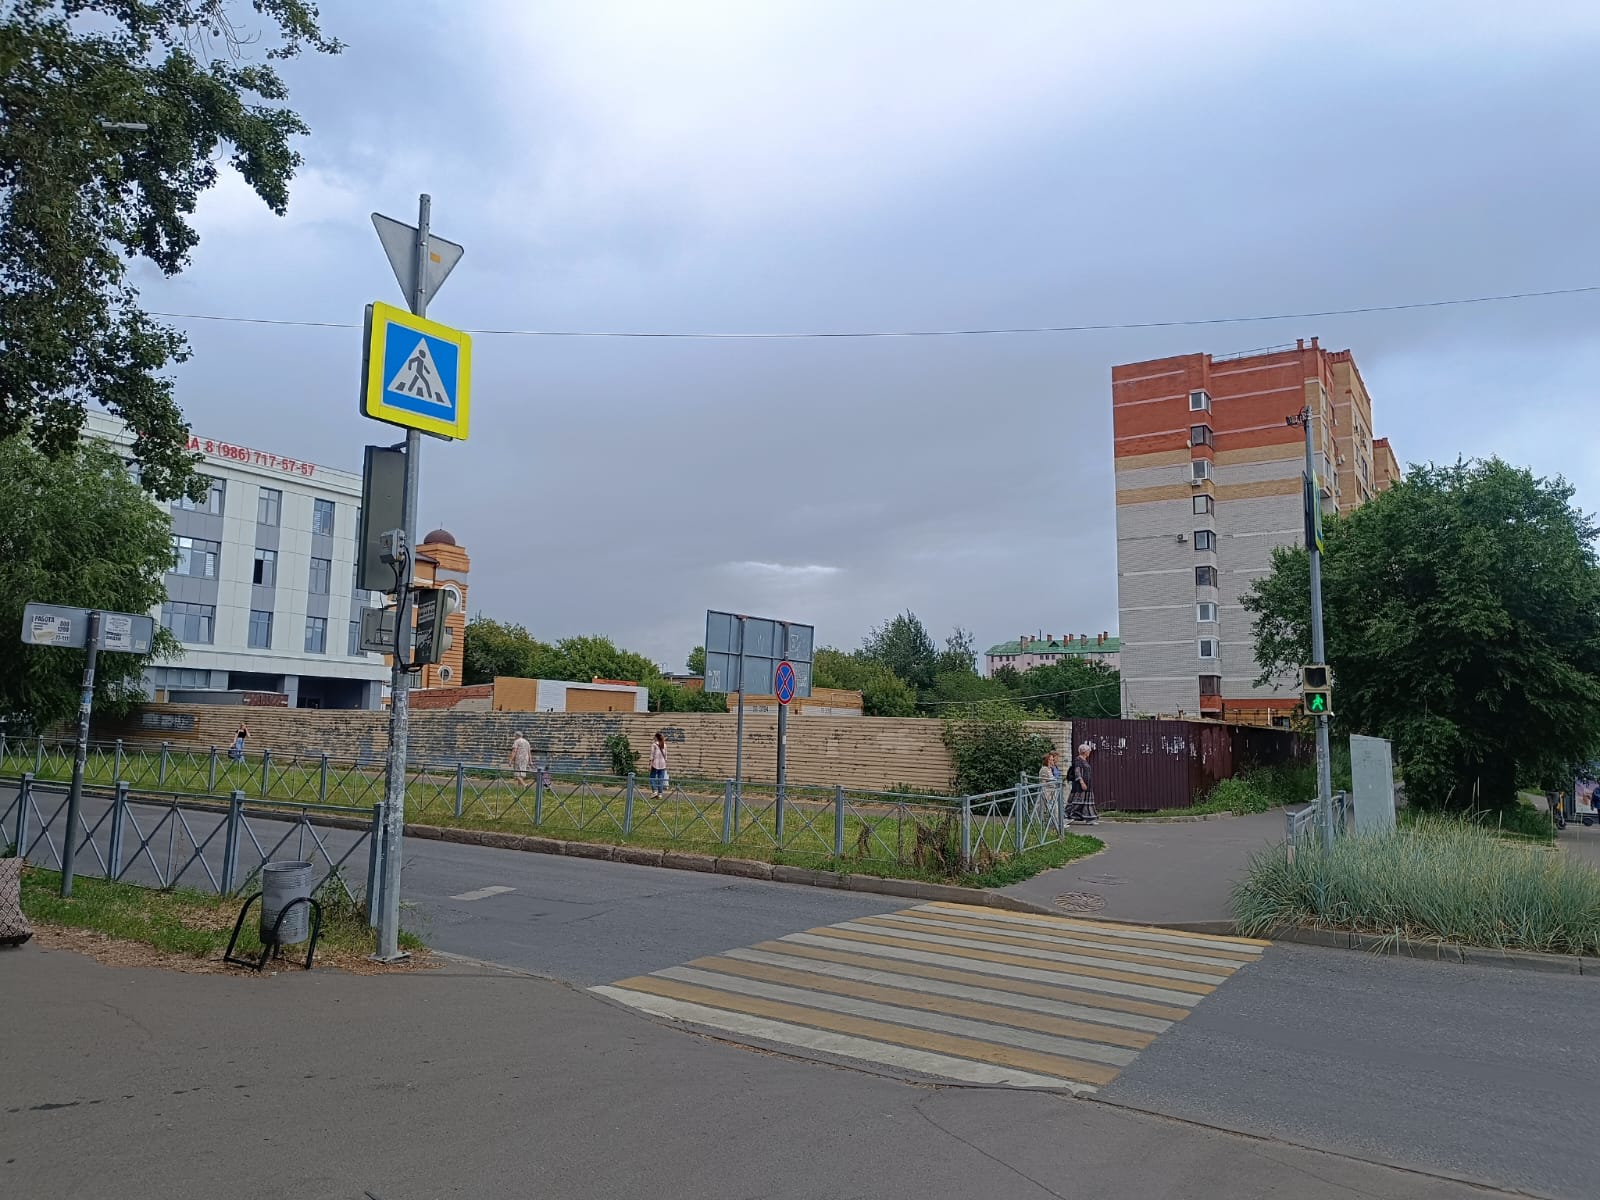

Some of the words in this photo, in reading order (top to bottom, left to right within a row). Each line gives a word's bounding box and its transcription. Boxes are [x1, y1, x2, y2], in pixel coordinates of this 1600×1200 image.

[205, 440, 213, 453] 8
[218, 442, 250, 463] (986)
[253, 451, 315, 476] 717-57-57
